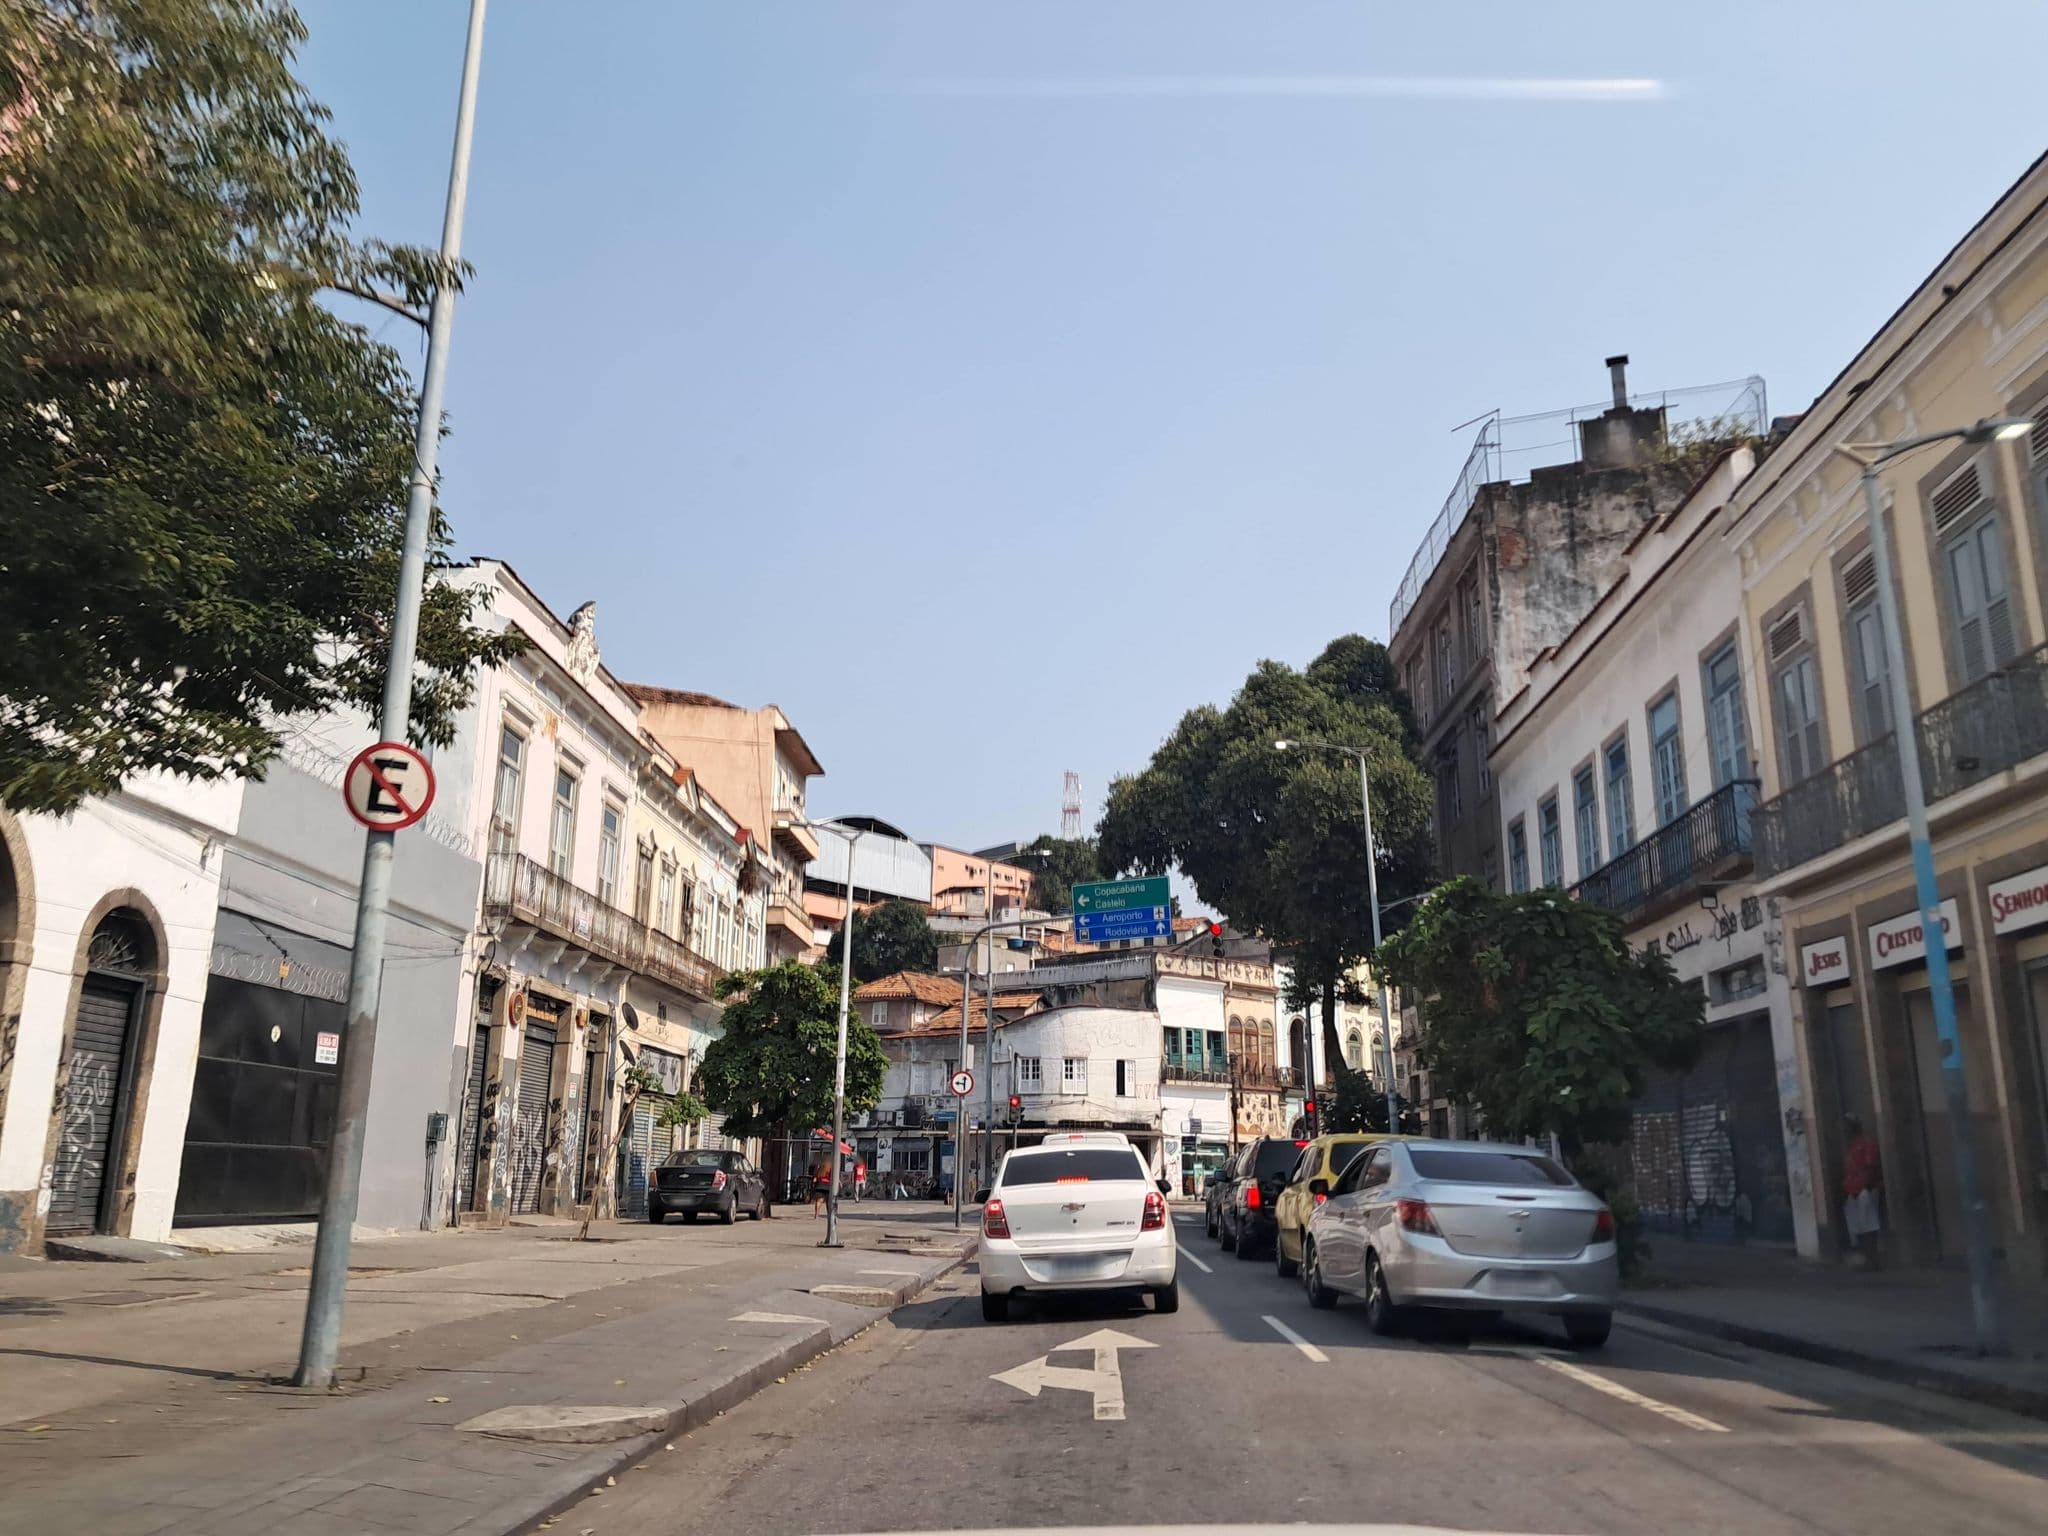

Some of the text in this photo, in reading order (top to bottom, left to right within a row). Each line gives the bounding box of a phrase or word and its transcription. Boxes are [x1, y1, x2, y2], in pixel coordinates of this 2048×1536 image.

[367, 758, 409, 814] E
[1094, 884, 1146, 897] Copacabana
[1095, 898, 1126, 909] Castelo
[1102, 911, 1143, 923] Aeroporto
[1105, 926, 1149, 937] Rodoviária
[1809, 950, 1841, 976] JESUS
